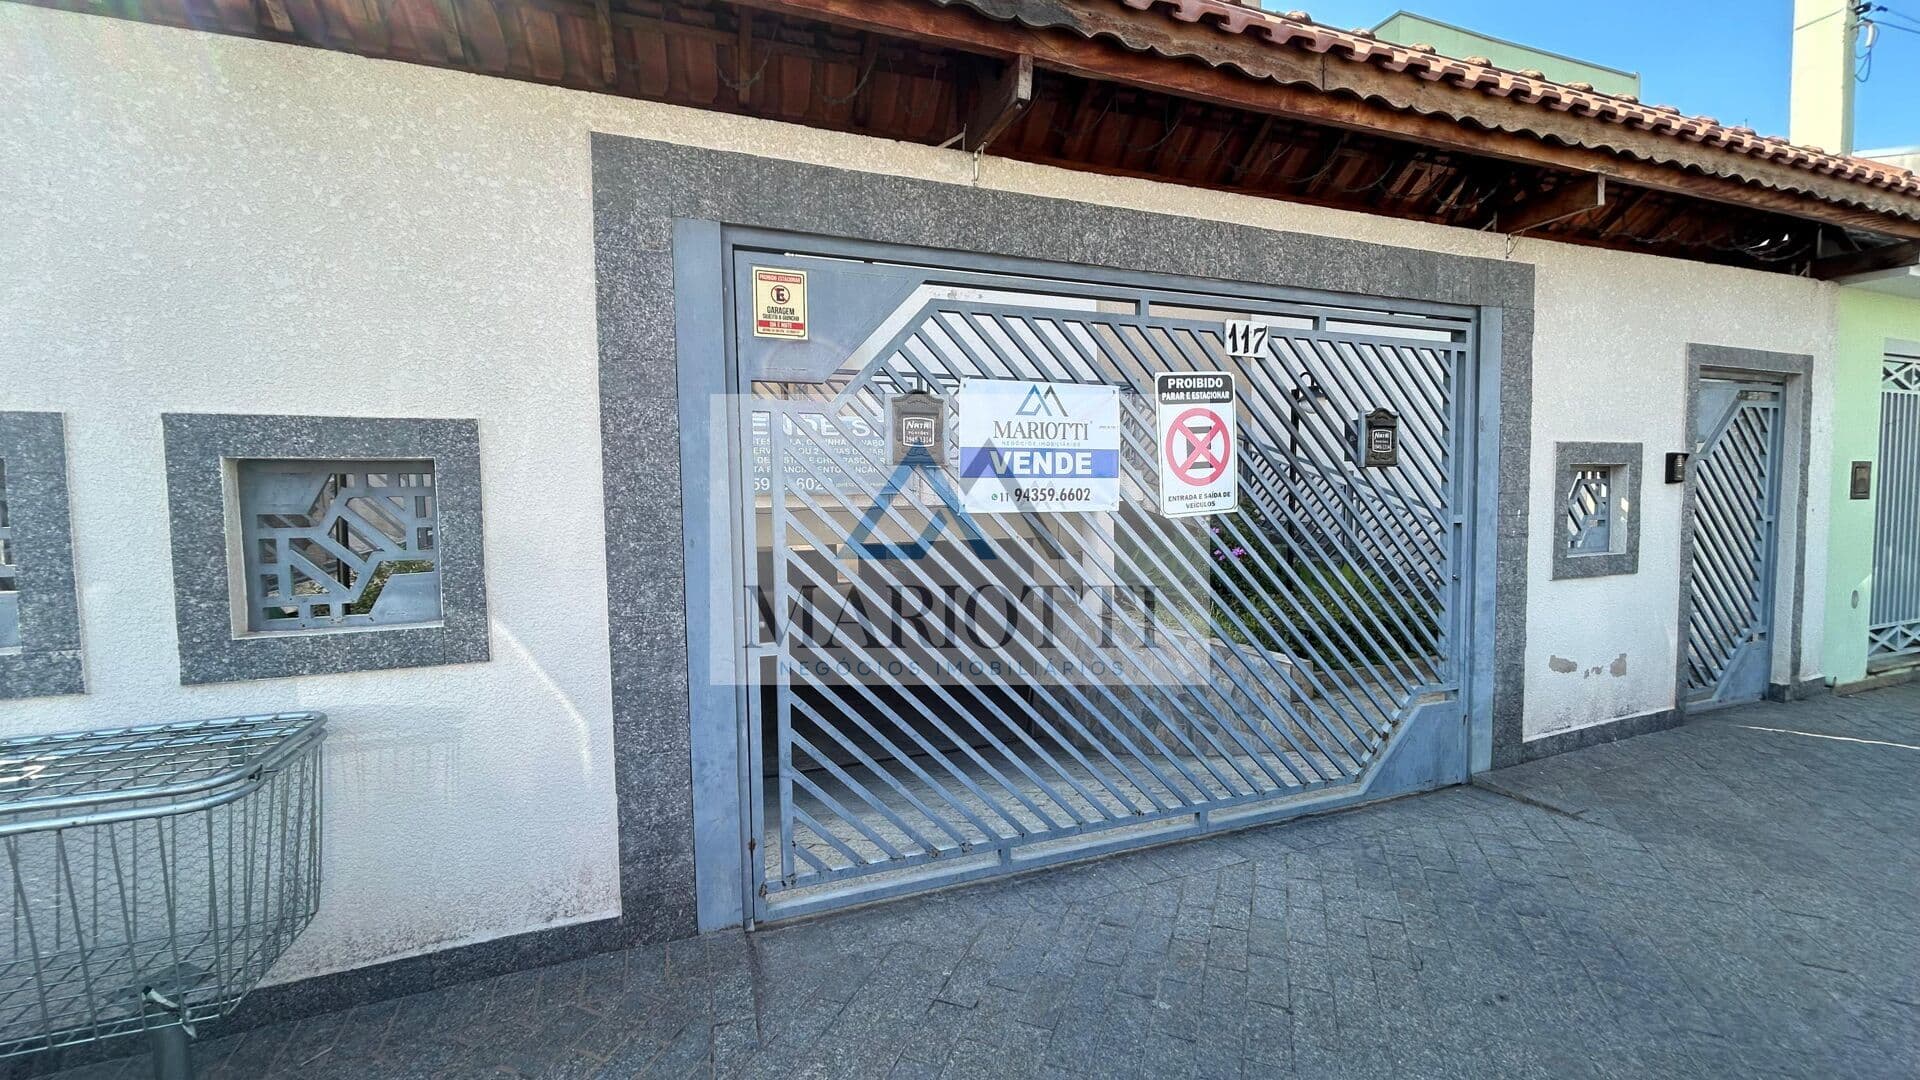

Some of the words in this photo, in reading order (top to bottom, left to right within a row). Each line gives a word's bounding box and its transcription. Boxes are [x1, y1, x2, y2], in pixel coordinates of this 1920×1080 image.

[766, 306, 795, 315] GARAGEM
[1228, 323, 1268, 354] 117
[1167, 377, 1223, 389] PROIBIDO
[1161, 391, 1185, 400] PARAR
[1186, 392, 1191, 400] E
[1191, 390, 1230, 400] ESTACIONAR
[993, 420, 1089, 440] MARIOTTI
[989, 451, 1092, 475] VENDE
[1000, 492, 1009, 502] 11
[1014, 488, 1091, 502] 94359.6602
[1168, 494, 1198, 502] ENTRADA
[1203, 491, 1222, 499] SAÍDA
